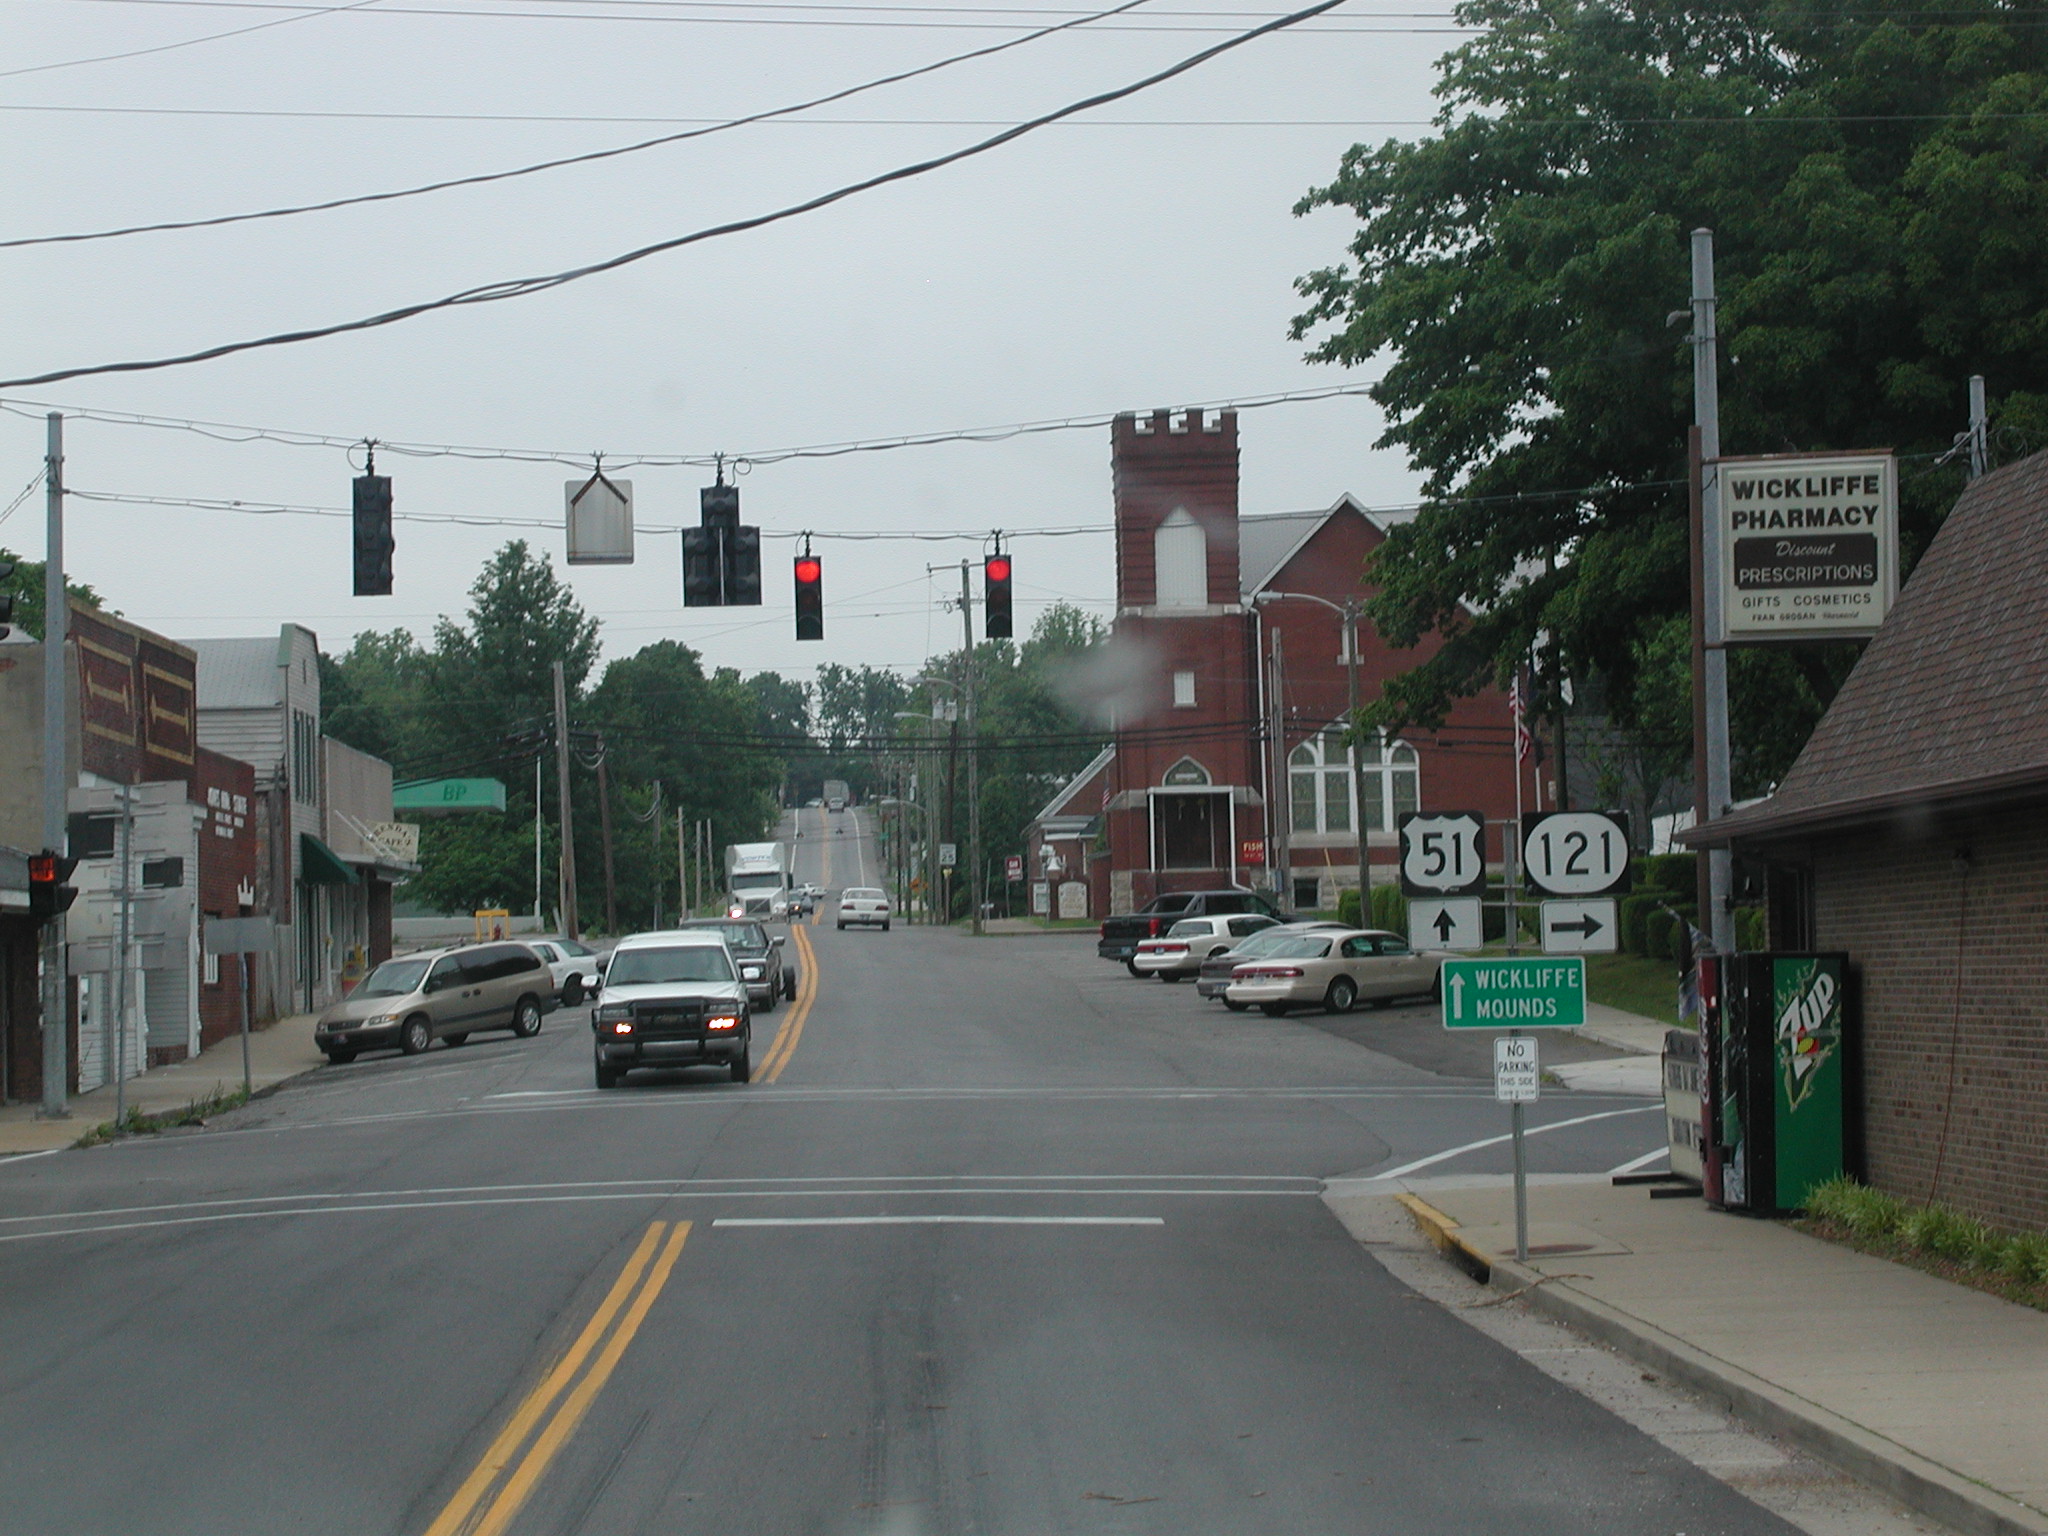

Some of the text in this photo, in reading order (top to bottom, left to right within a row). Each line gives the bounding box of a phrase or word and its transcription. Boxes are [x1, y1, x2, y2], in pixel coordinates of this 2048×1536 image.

[1732, 475, 1878, 499] WICKLIFFE
[1732, 505, 1878, 529] PHARMACY
[1775, 540, 1836, 557] Discount
[1739, 563, 1874, 584] PRESCRIPTIONS
[1742, 593, 1871, 609] GIFTS COSMETICS
[443, 783, 468, 801] BP
[1243, 841, 1264, 852] FISH
[1422, 831, 1462, 877] 51
[1541, 830, 1611, 877] 121
[941, 852, 955, 862] 25
[1475, 967, 1579, 990] WICKLIFFE
[1476, 998, 1557, 1020] MOUNDS
[1507, 1044, 1525, 1057] NO
[1498, 1061, 1535, 1073] PARKING
